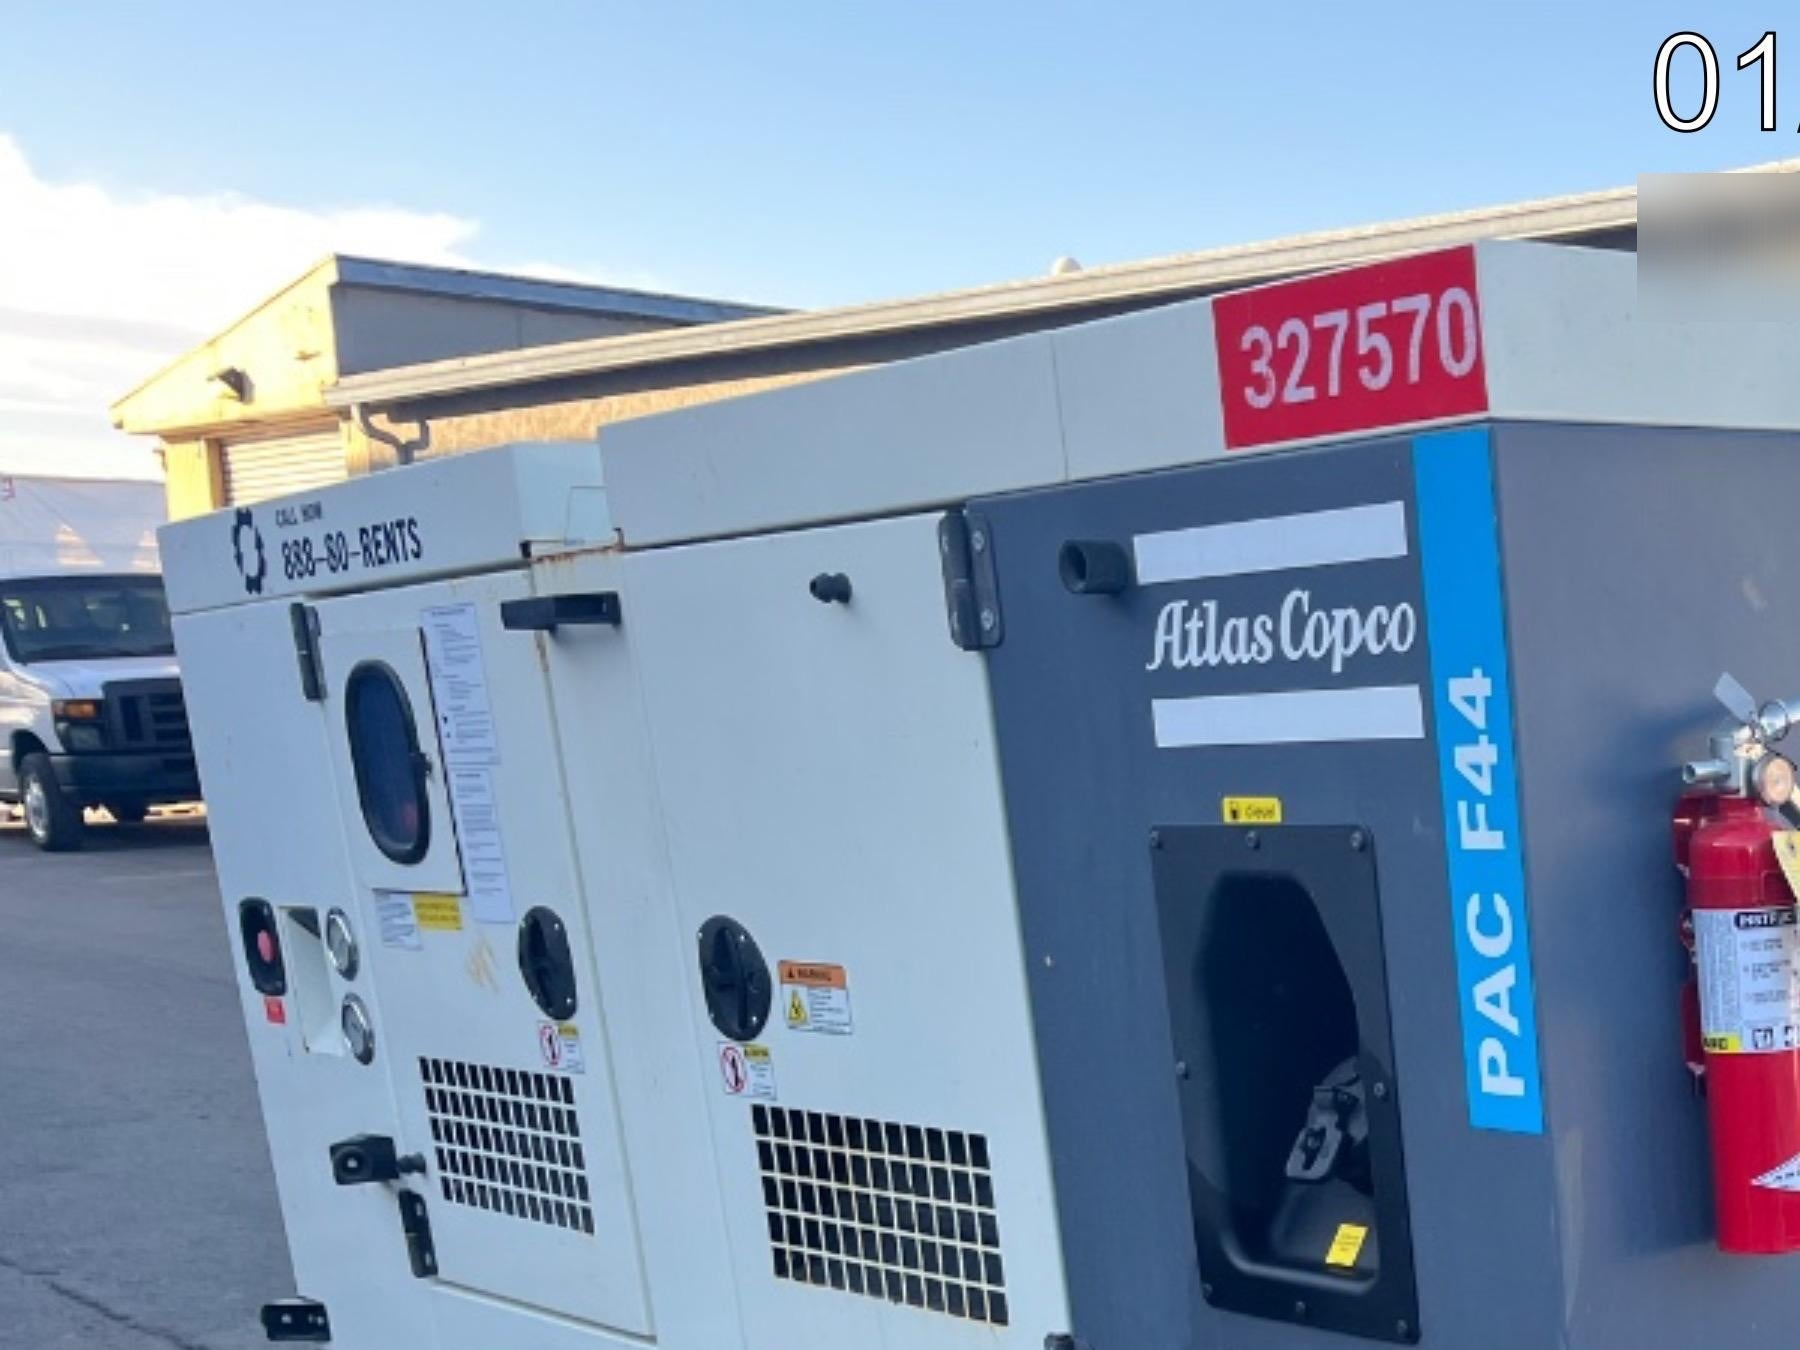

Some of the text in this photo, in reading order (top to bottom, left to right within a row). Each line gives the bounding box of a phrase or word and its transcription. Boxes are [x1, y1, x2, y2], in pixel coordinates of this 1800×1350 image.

[1240, 286, 1478, 409] 327570
[275, 506, 298, 528] CALL
[282, 516, 423, 580] 888-80-RENTS
[1145, 587, 1417, 674] Atlas Copco
[1447, 666, 1527, 1097] PAC F44
